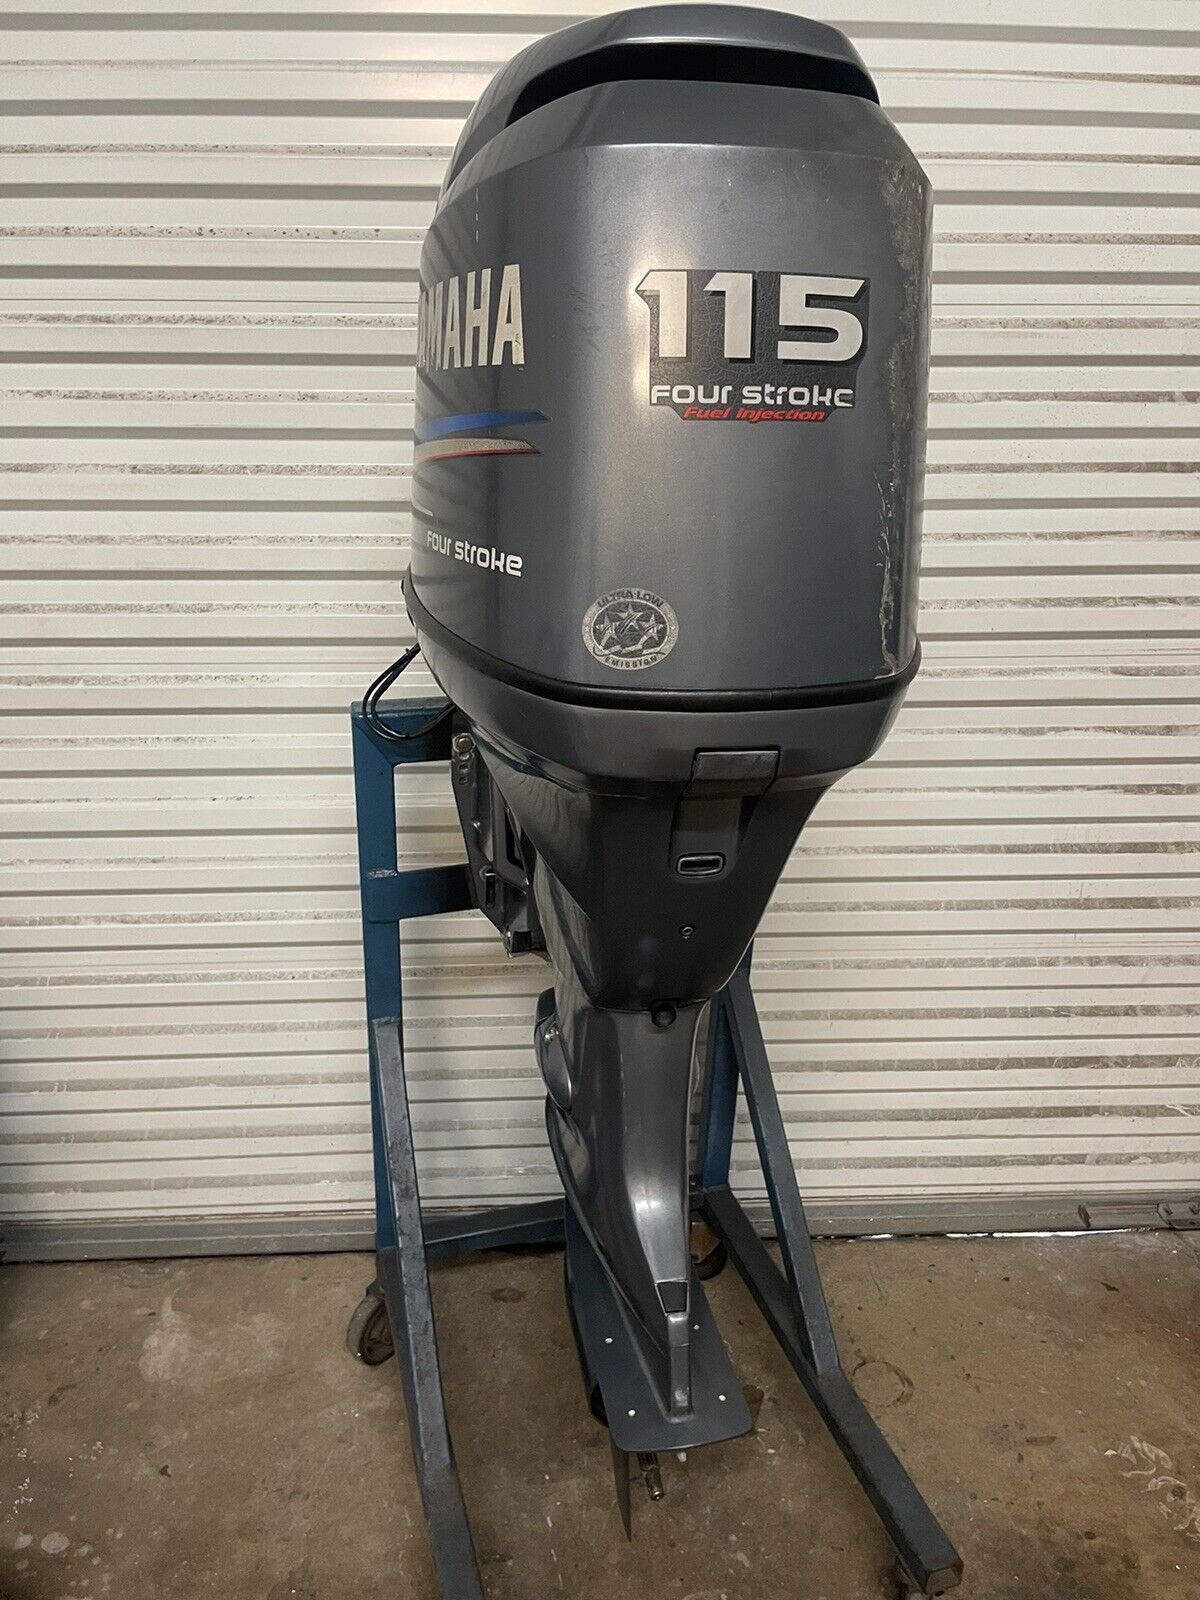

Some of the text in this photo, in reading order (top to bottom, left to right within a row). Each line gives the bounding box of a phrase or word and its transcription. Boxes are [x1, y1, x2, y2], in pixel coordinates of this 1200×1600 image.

[417, 264, 525, 373] AMAHA
[636, 271, 865, 361] 115
[683, 406, 826, 423] Fuel Injection
[454, 540, 523, 577] stroke
[604, 656, 658, 669] EMISSION
